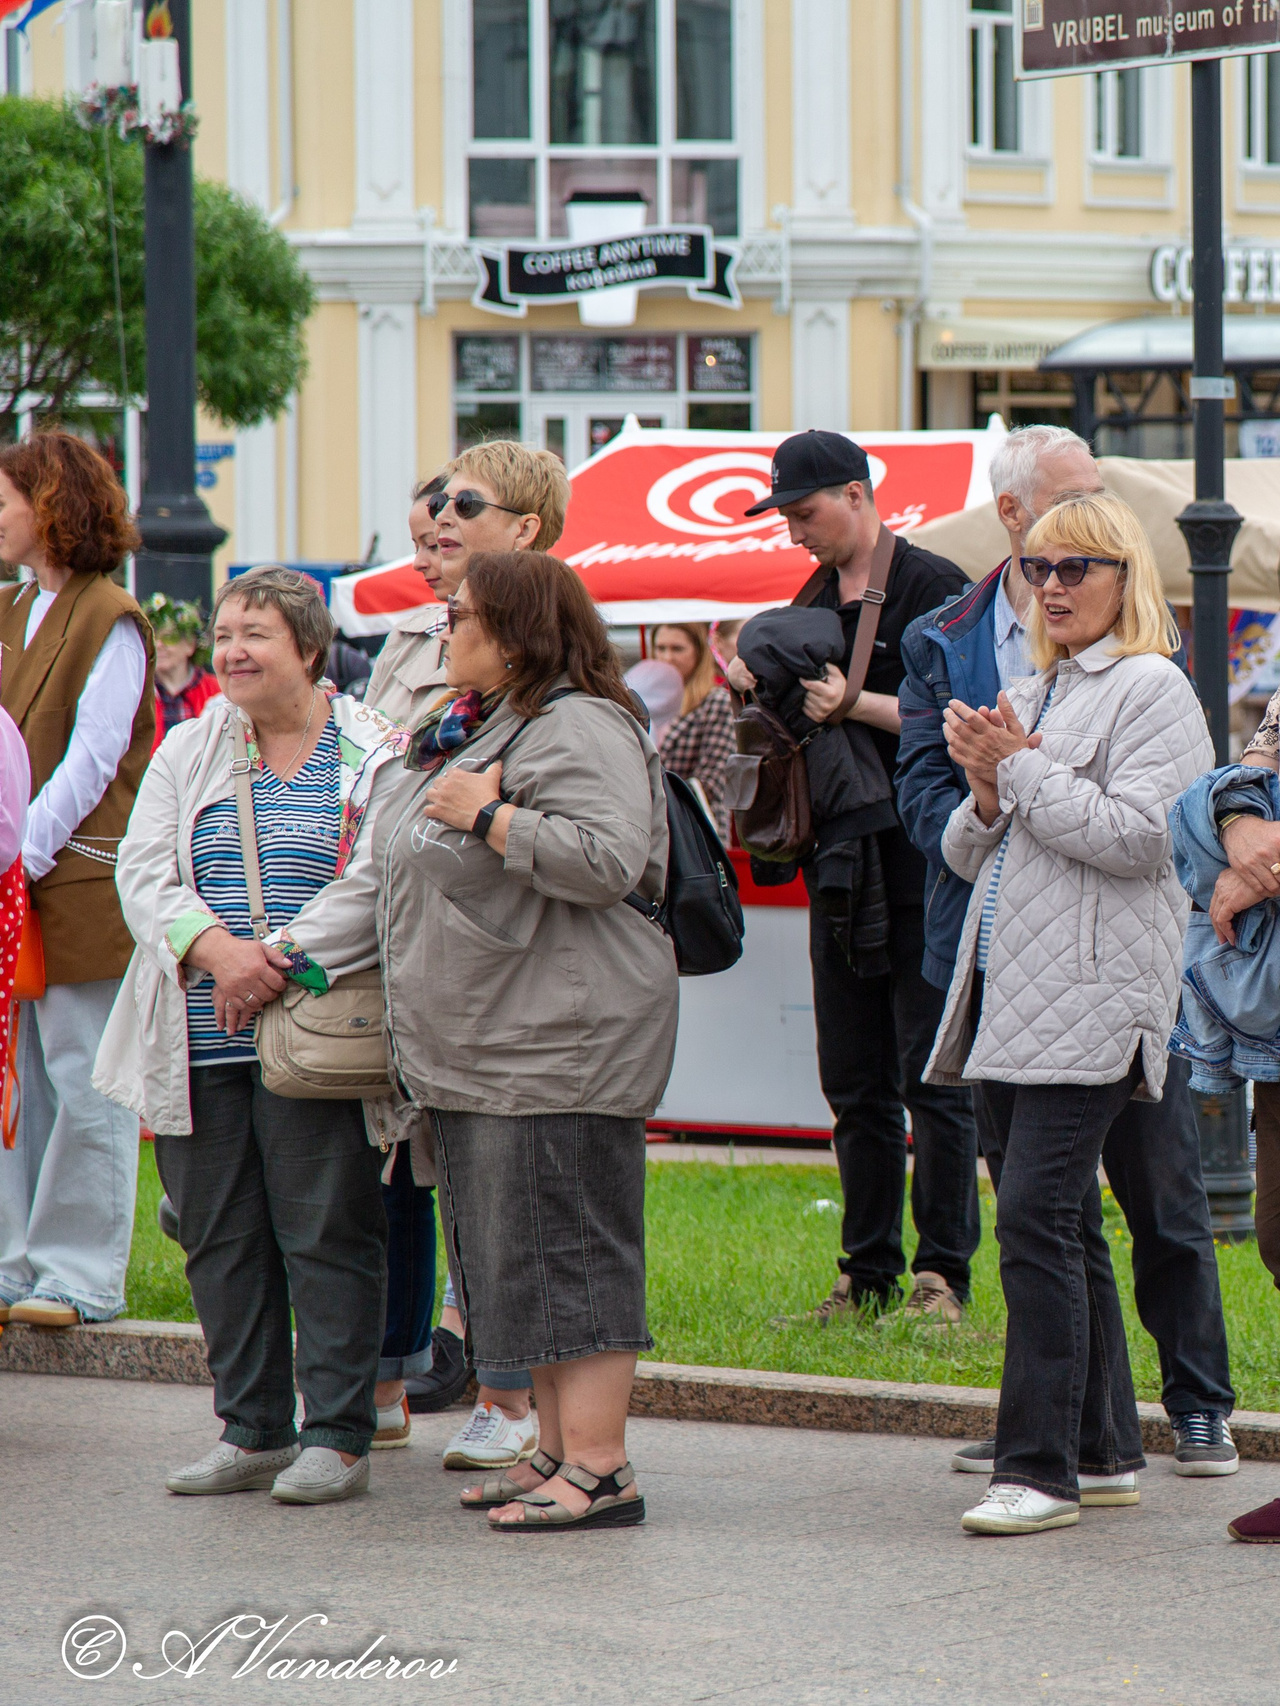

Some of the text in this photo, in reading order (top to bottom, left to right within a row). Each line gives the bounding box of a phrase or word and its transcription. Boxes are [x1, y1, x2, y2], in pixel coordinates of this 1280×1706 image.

[1052, 14, 1130, 48] VRUBEL
[1136, 8, 1215, 37] museum
[1222, 0, 1244, 27] of
[522, 233, 692, 276] COFFEE ANYTIME
